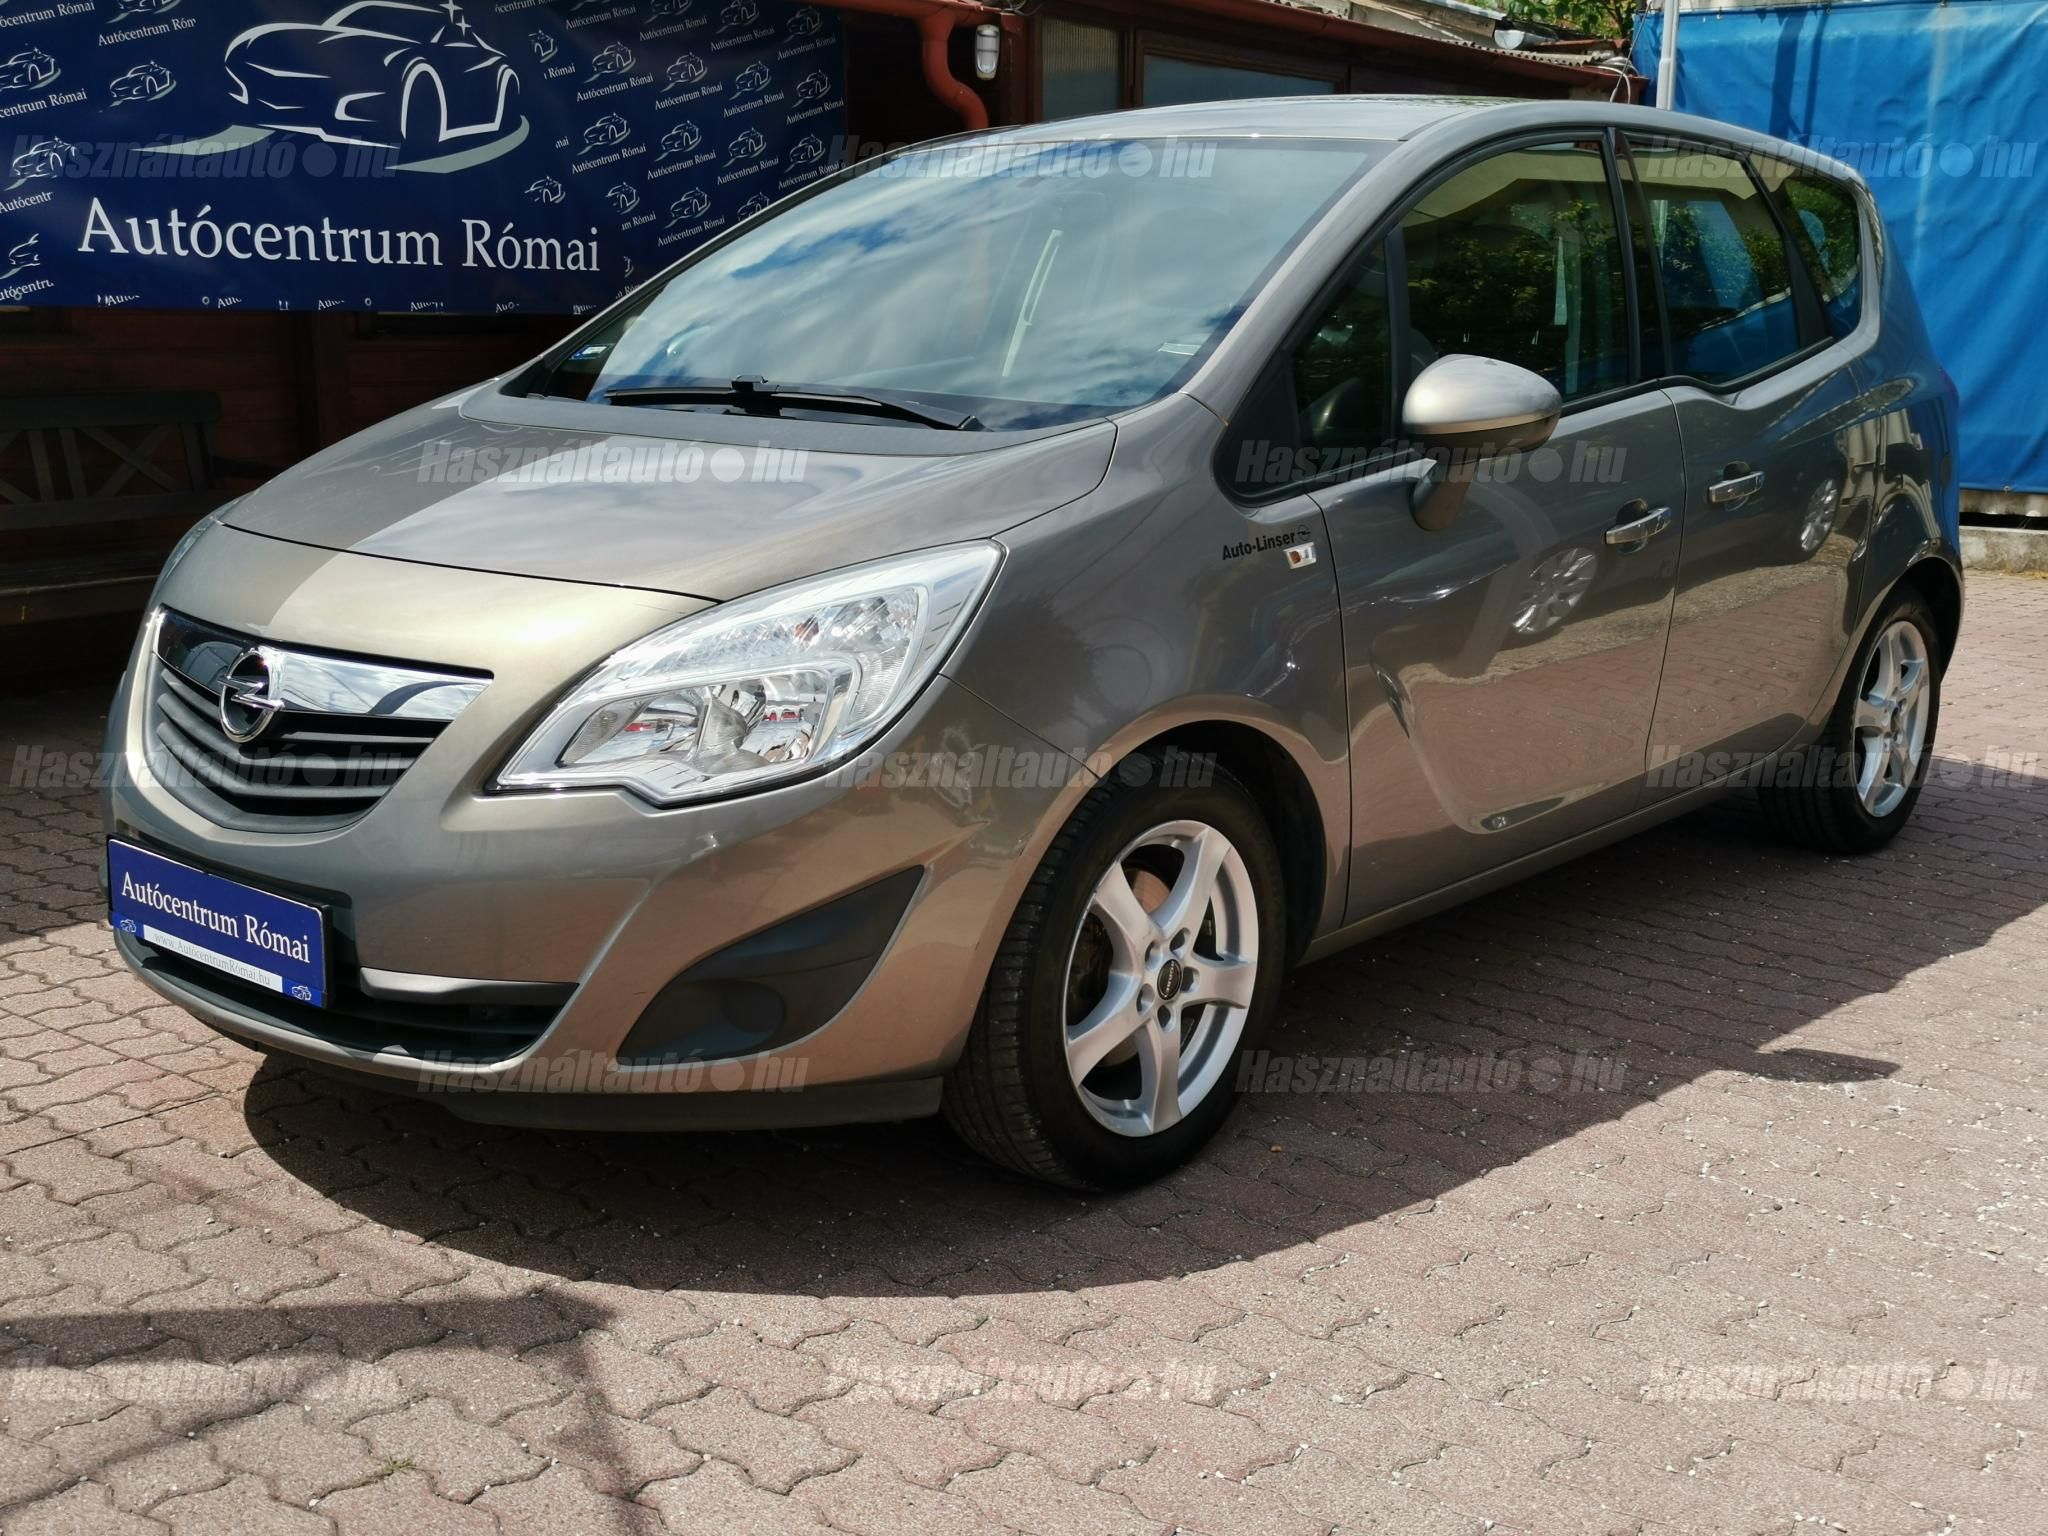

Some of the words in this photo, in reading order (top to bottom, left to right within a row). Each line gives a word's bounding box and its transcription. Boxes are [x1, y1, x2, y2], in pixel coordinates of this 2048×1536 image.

[57, 1, 95, 17] Római
[565, 12, 611, 31] Autócentrum
[612, 6, 636, 18] Római
[98, 23, 170, 46] Autócentrum
[549, 62, 576, 79] Római
[49, 88, 87, 106] Római
[576, 82, 628, 102] Autócentrum
[629, 72, 654, 88] Római
[655, 90, 700, 110] Autócentrum
[701, 81, 723, 97] Római
[723, 100, 763, 118] Autócentrum
[572, 154, 620, 175] Autócentrum
[621, 143, 646, 159] Római
[647, 161, 694, 180] Autócentrum
[694, 150, 716, 165] Római
[717, 166, 759, 186] Autócentrum
[632, 211, 656, 227] Római
[657, 226, 703, 247] Autócentrum
[703, 215, 725, 231] Római
[78, 197, 442, 266] Autócentrum
[461, 218, 600, 272] Római
[1222, 531, 1295, 560] Auto-Linser
[121, 871, 239, 939] Autócentrum
[244, 914, 311, 964] Római
